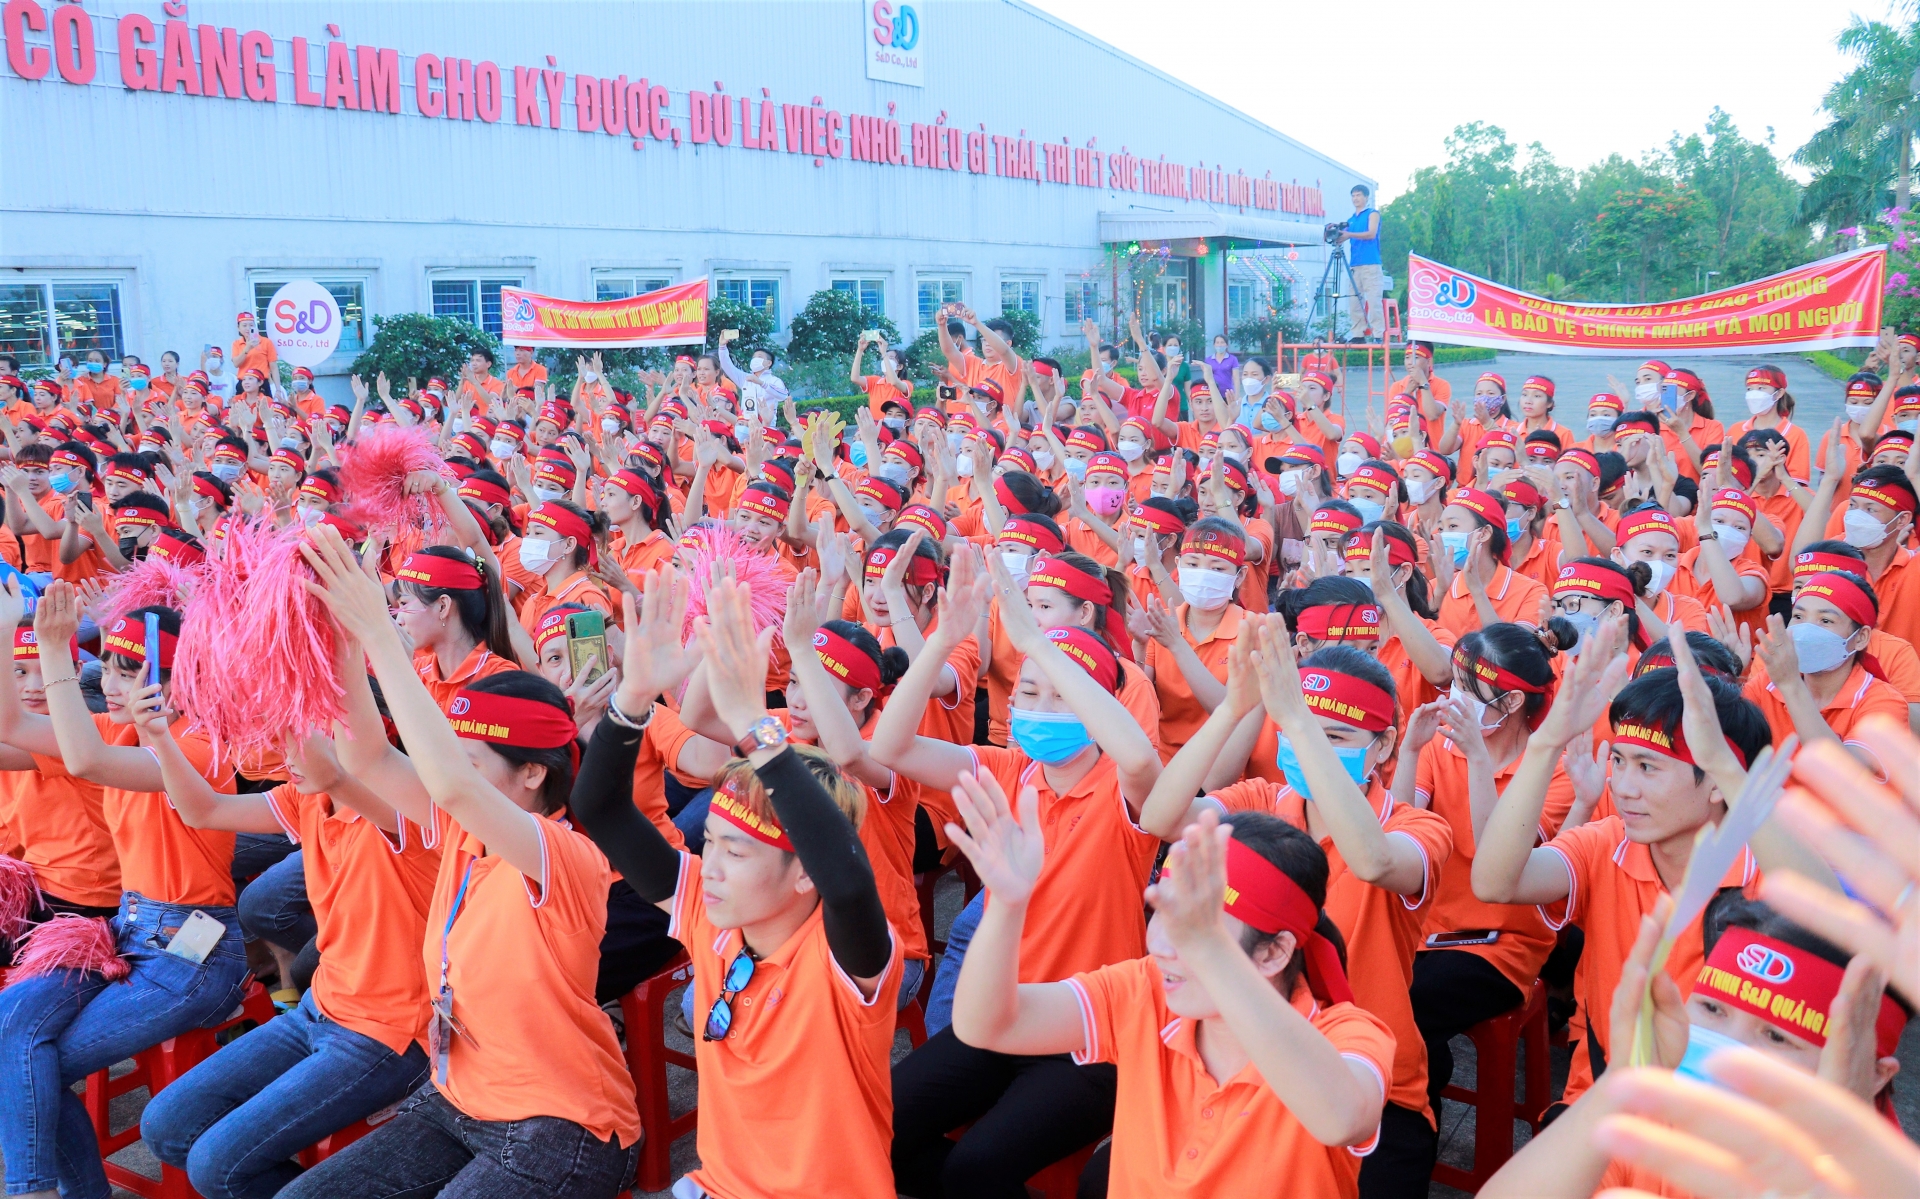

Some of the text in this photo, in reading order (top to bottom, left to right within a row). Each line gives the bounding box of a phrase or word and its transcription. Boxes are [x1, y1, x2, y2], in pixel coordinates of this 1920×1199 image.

[873, 0, 920, 50] S&D
[292, 23, 400, 114] LÀM
[414, 52, 502, 124] CHO
[514, 55, 566, 129] KỲ
[575, 73, 682, 150] ĐƯỢC,
[690, 80, 733, 148] DÙ
[741, 87, 780, 151] LÀ
[783, 95, 844, 167] VIỆC
[850, 101, 909, 165] NHỎ.
[911, 110, 963, 171] ĐIỀU
[968, 122, 989, 175] GÌ
[992, 129, 1042, 186] TRÁI,
[1043, 136, 1072, 185] THÌ
[1075, 136, 1106, 188] HẾT
[1109, 145, 1139, 192] SỨC
[1209, 164, 1225, 204] LÀ
[1409, 268, 1477, 309] S&D
[1700, 294, 1749, 310] GIAO
[275, 300, 332, 334] S&D
[503, 296, 535, 322] S&D
[659, 301, 679, 326] GIAO
[680, 294, 703, 323] THÔNG
[1410, 307, 1430, 318] S&D
[1456, 312, 1473, 322] Ltd
[1485, 307, 1507, 328] LÀ
[1511, 309, 1549, 333] BẢO
[1553, 317, 1577, 338] VỆ
[1715, 316, 1742, 335] VÀ
[1749, 312, 1791, 335] MỌI
[1798, 298, 1864, 328] NGƯỜI
[296, 339, 313, 348] Co.,
[315, 339, 329, 347] Ltd
[1347, 705, 1366, 722] BÌNH
[487, 724, 509, 739] BÌNH
[1711, 966, 1741, 998] TNHH
[1739, 982, 1773, 1010] S&D
[1771, 995, 1826, 1035] QUẢNG
